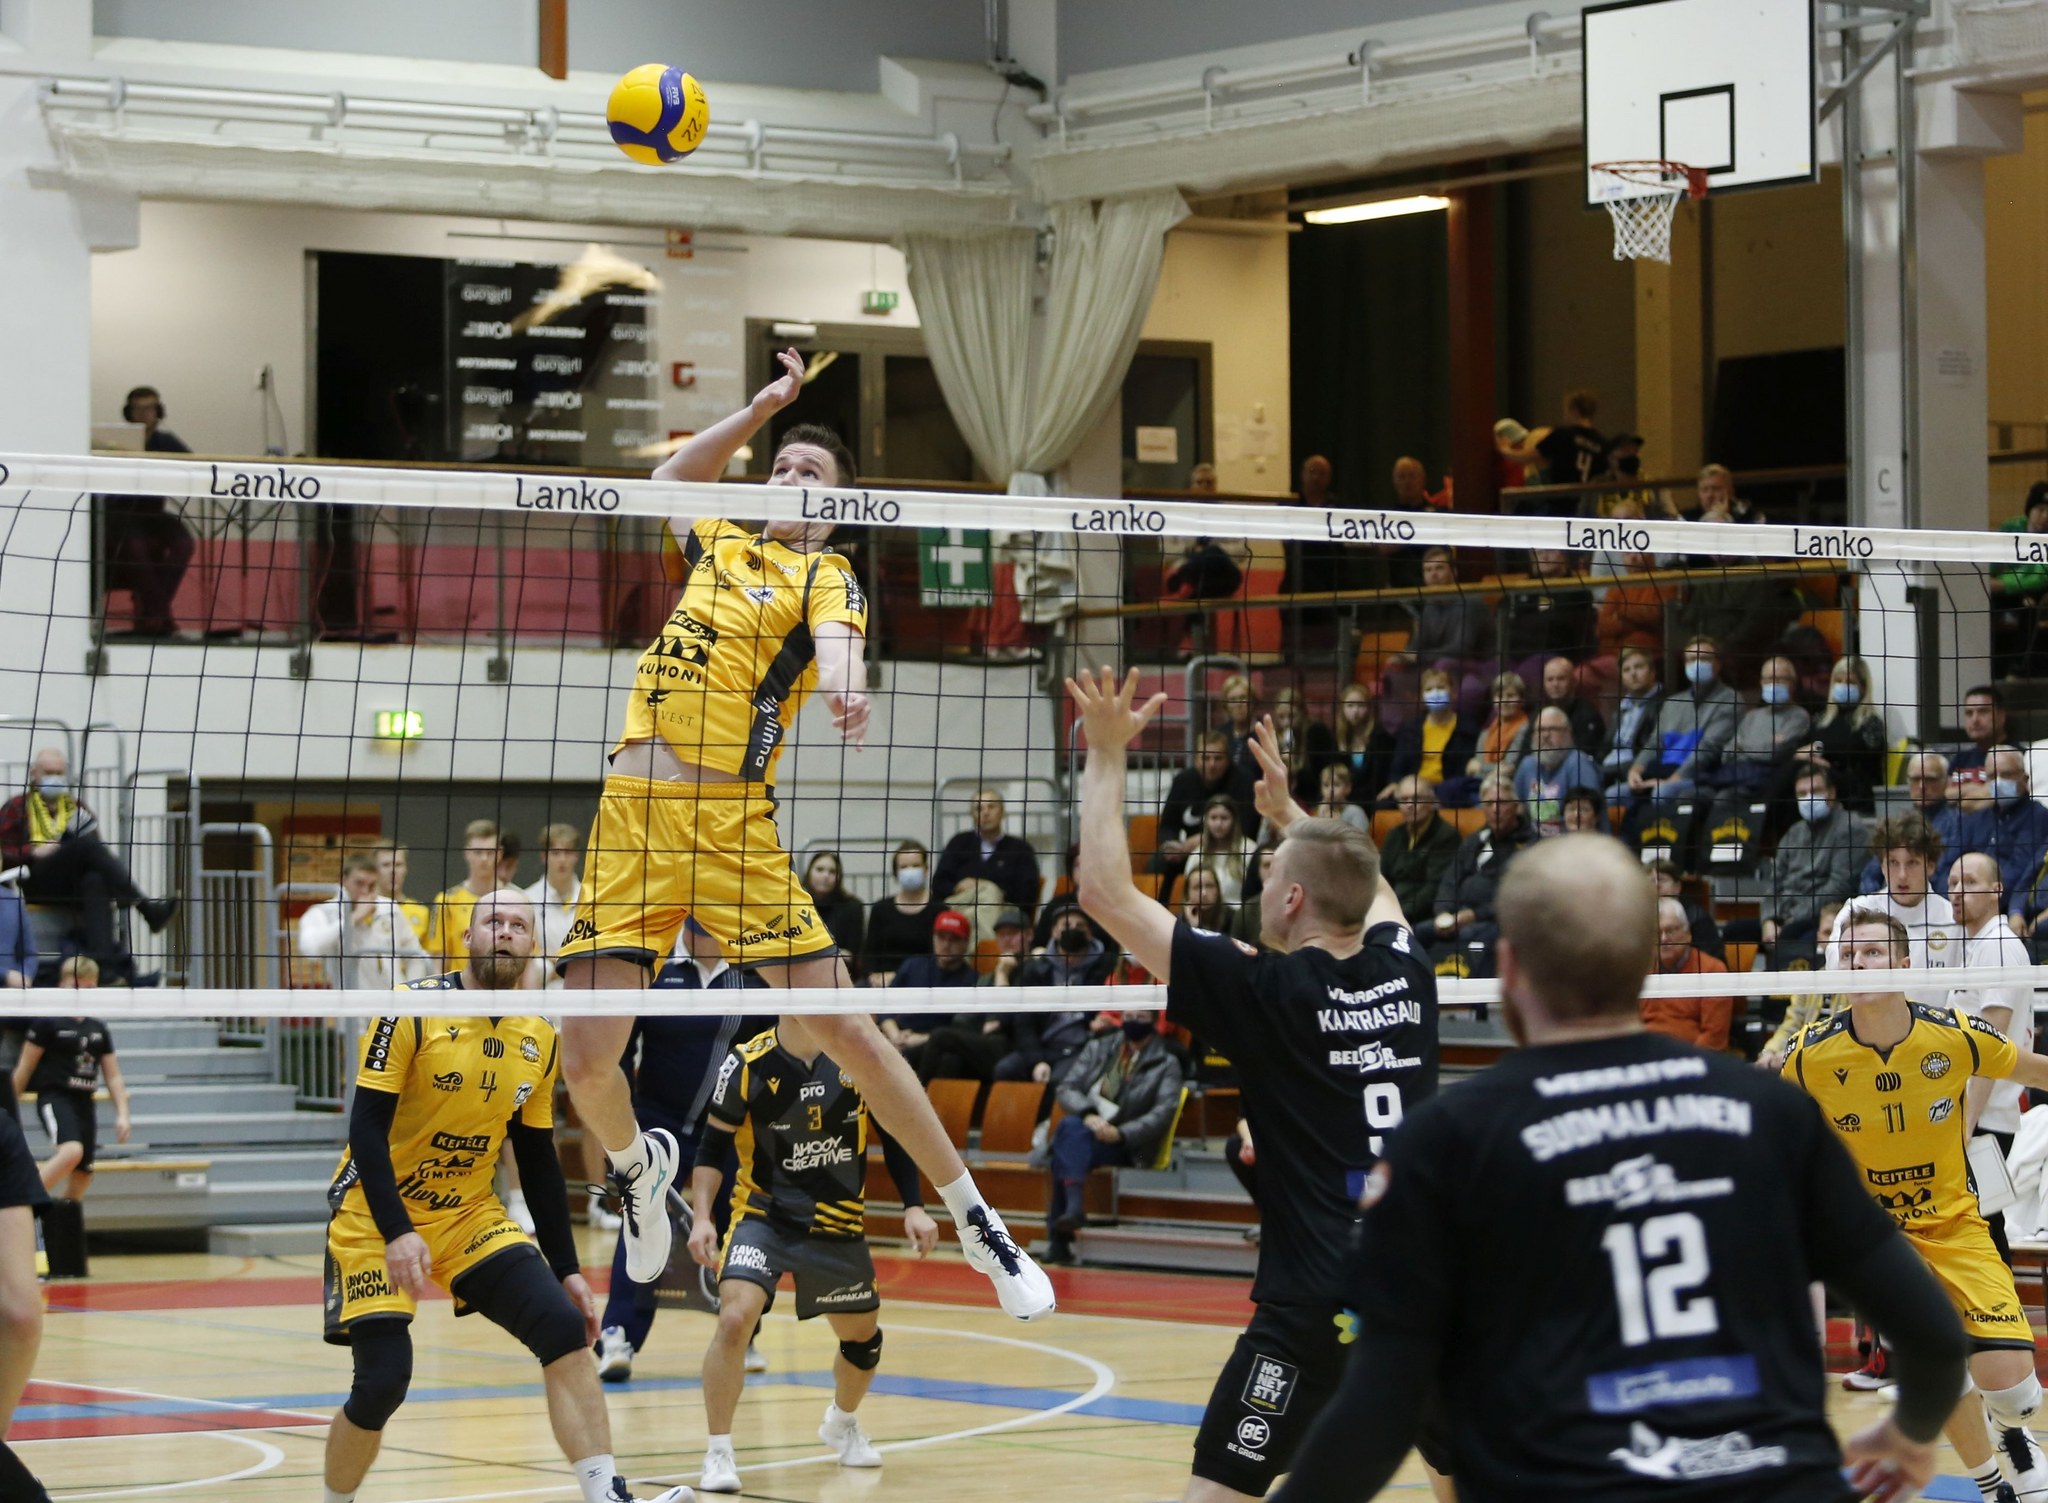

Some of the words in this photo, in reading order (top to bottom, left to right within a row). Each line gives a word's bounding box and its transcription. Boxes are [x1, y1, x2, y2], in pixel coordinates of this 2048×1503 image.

[671, 86, 680, 106] FIVB
[211, 464, 321, 500] Lanko
[1877, 468, 1891, 494] C
[516, 478, 620, 512] Lanko
[802, 488, 900, 523] Lanko
[1072, 501, 1165, 533] Lanko
[1326, 510, 1415, 544] Lanko
[1566, 520, 1650, 551] Lanko
[1794, 528, 1874, 560] Lanko
[638, 662, 702, 684] KUMONI
[1317, 1000, 1422, 1033] KAATRASALO
[482, 1036, 505, 1059] OLVI
[1385, 1056, 1422, 1069] PREMIUM
[432, 1081, 463, 1093] WULFF
[479, 1070, 498, 1103] 4
[1876, 1072, 1902, 1092] OLVI
[807, 1104, 822, 1131] 3
[1363, 1082, 1404, 1158] 9
[1520, 1093, 1752, 1162] SUOMALAINEN
[1881, 1102, 1906, 1134] 11
[1871, 1166, 1931, 1184] KEITELE
[397, 1174, 463, 1211] Hurja
[732, 1244, 768, 1266] SAVON
[1602, 1211, 1720, 1349] 12
[816, 1291, 872, 1304] PIELISPAKARI
[1256, 1372, 1288, 1392] NEY
[1260, 1360, 1283, 1378] HO
[1252, 1385, 1282, 1404] STY
[1241, 1422, 1266, 1442] BE
[1227, 1442, 1239, 1453] BE
[1238, 1446, 1266, 1462] GROUP
